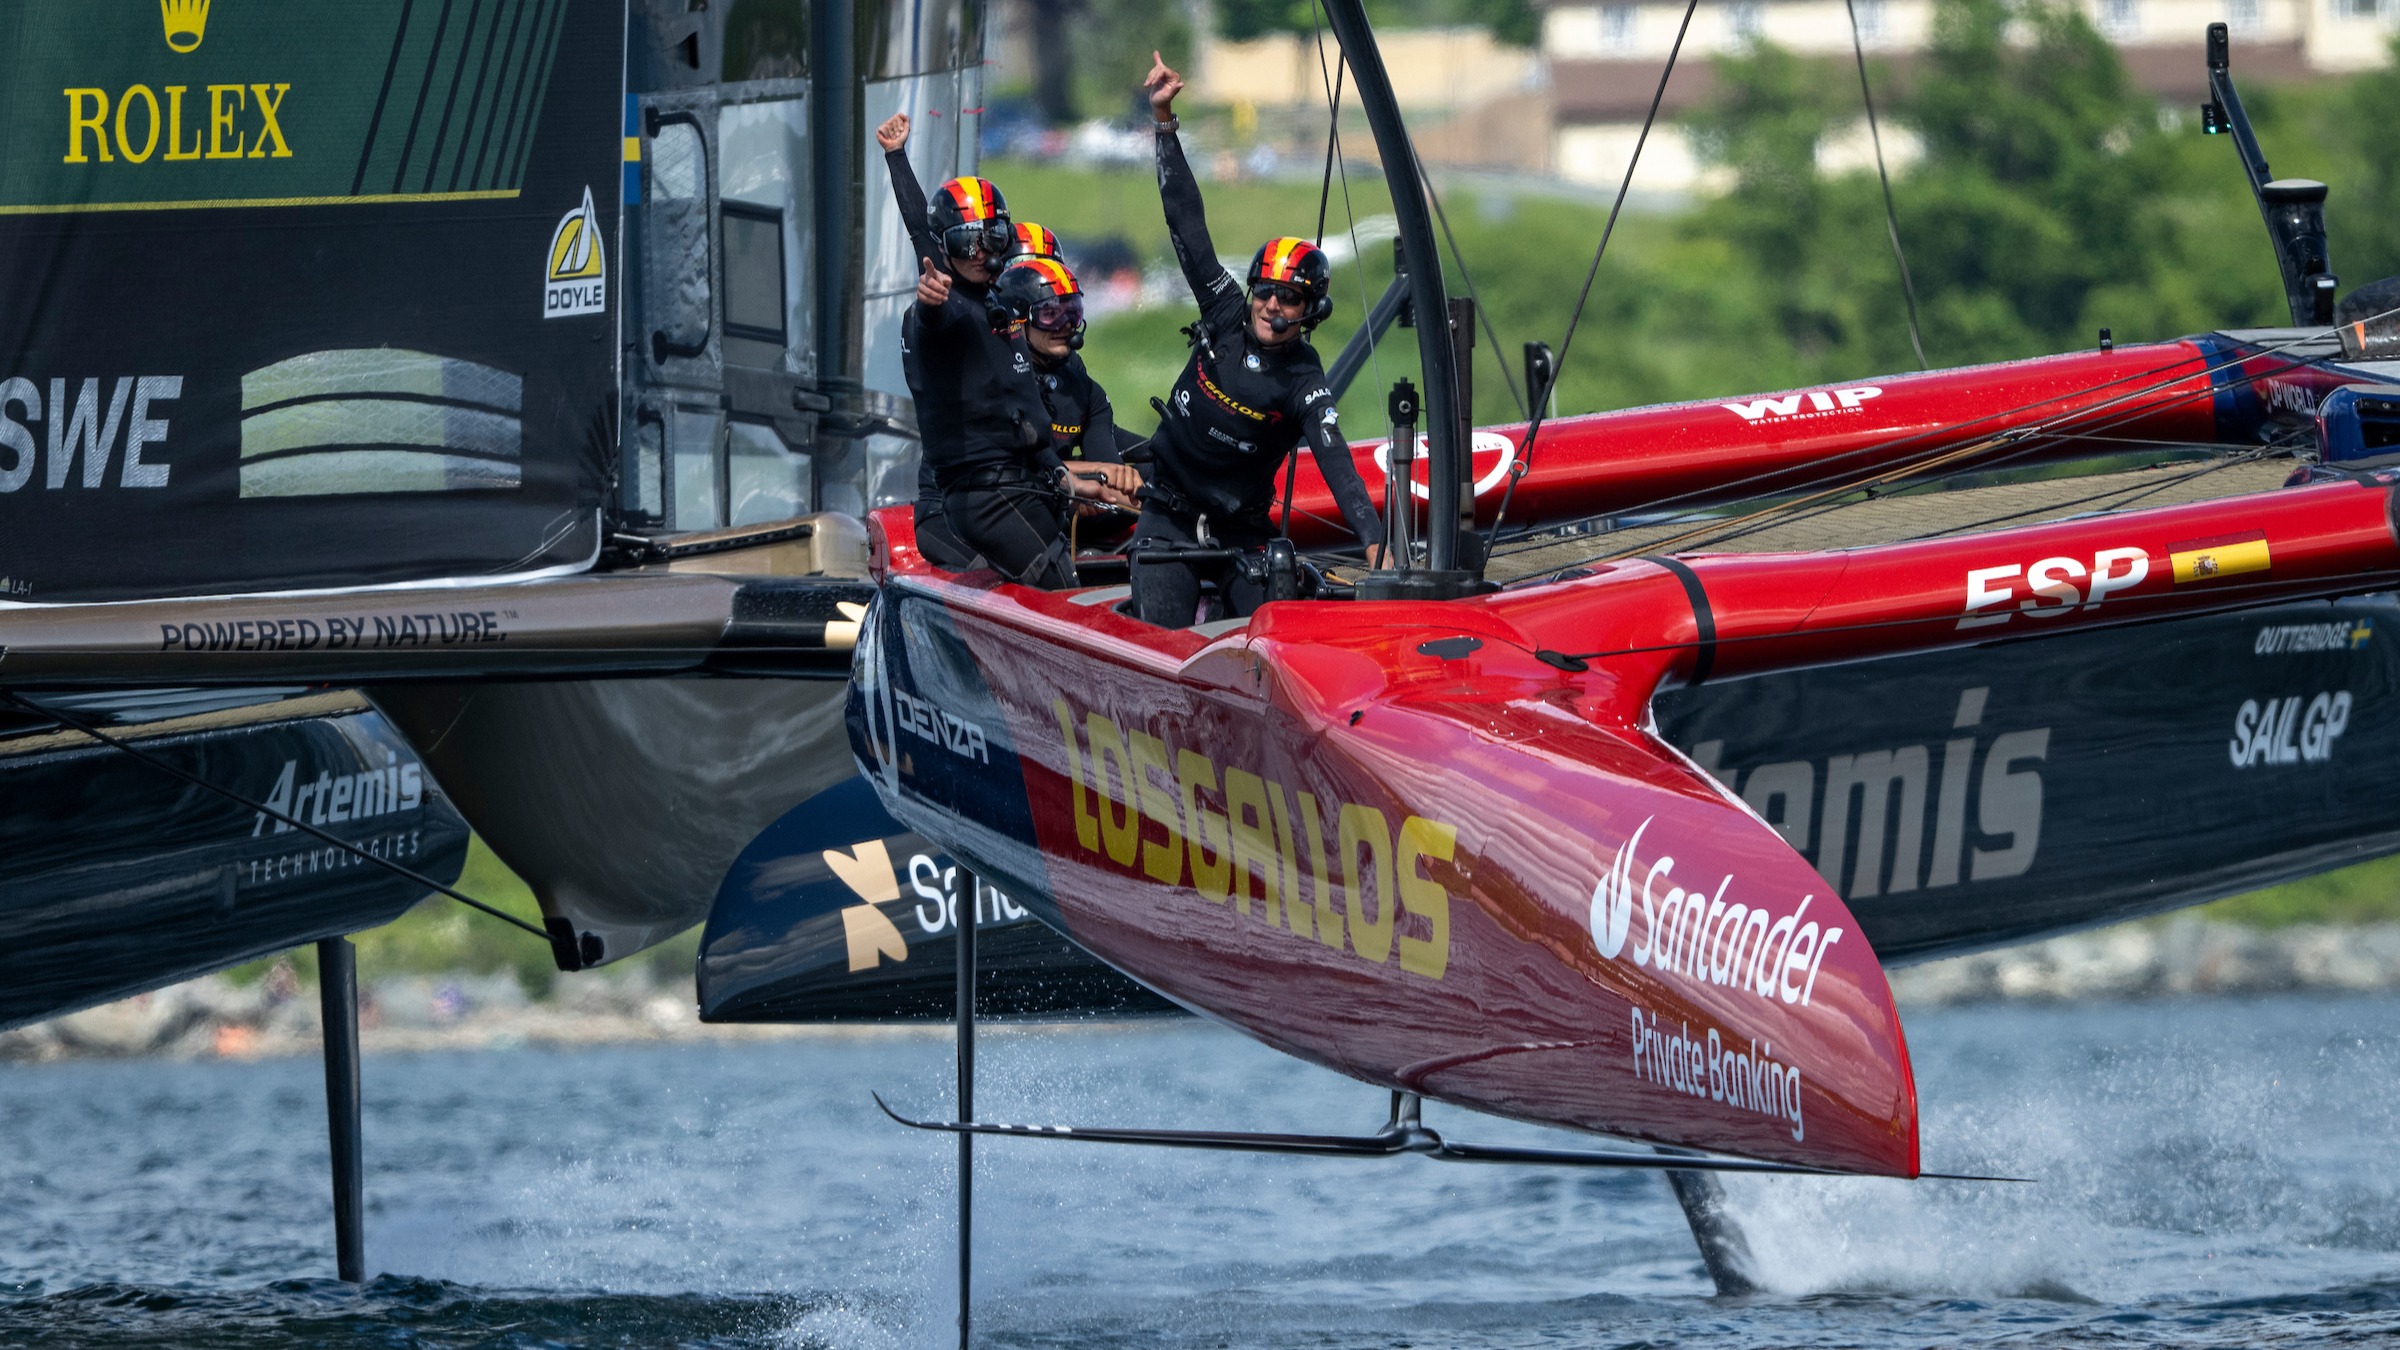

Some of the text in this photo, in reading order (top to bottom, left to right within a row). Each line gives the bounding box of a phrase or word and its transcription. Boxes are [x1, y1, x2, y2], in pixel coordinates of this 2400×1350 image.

[63, 83, 293, 164] ROLEX
[547, 285, 603, 311] DOYLE
[0, 375, 183, 492] SWE
[1720, 387, 1883, 420] WIP
[1749, 406, 1864, 427] WATER PROTECTION
[11, 579, 33, 596] LA-1
[1955, 546, 2150, 631] ESP
[160, 620, 321, 651] POWERED
[326, 617, 365, 649] BY
[372, 611, 507, 648] NATURE.
[2254, 621, 2352, 655] OUTTERIDGE
[894, 687, 990, 765] DENZA
[251, 750, 423, 838] Artemis
[250, 831, 420, 884] TECHNOLOGIES
[1053, 699, 1458, 980] LOSGALLOS
[1633, 856, 1844, 1007] Santander
[1631, 1006, 1805, 1142] Private Banking
